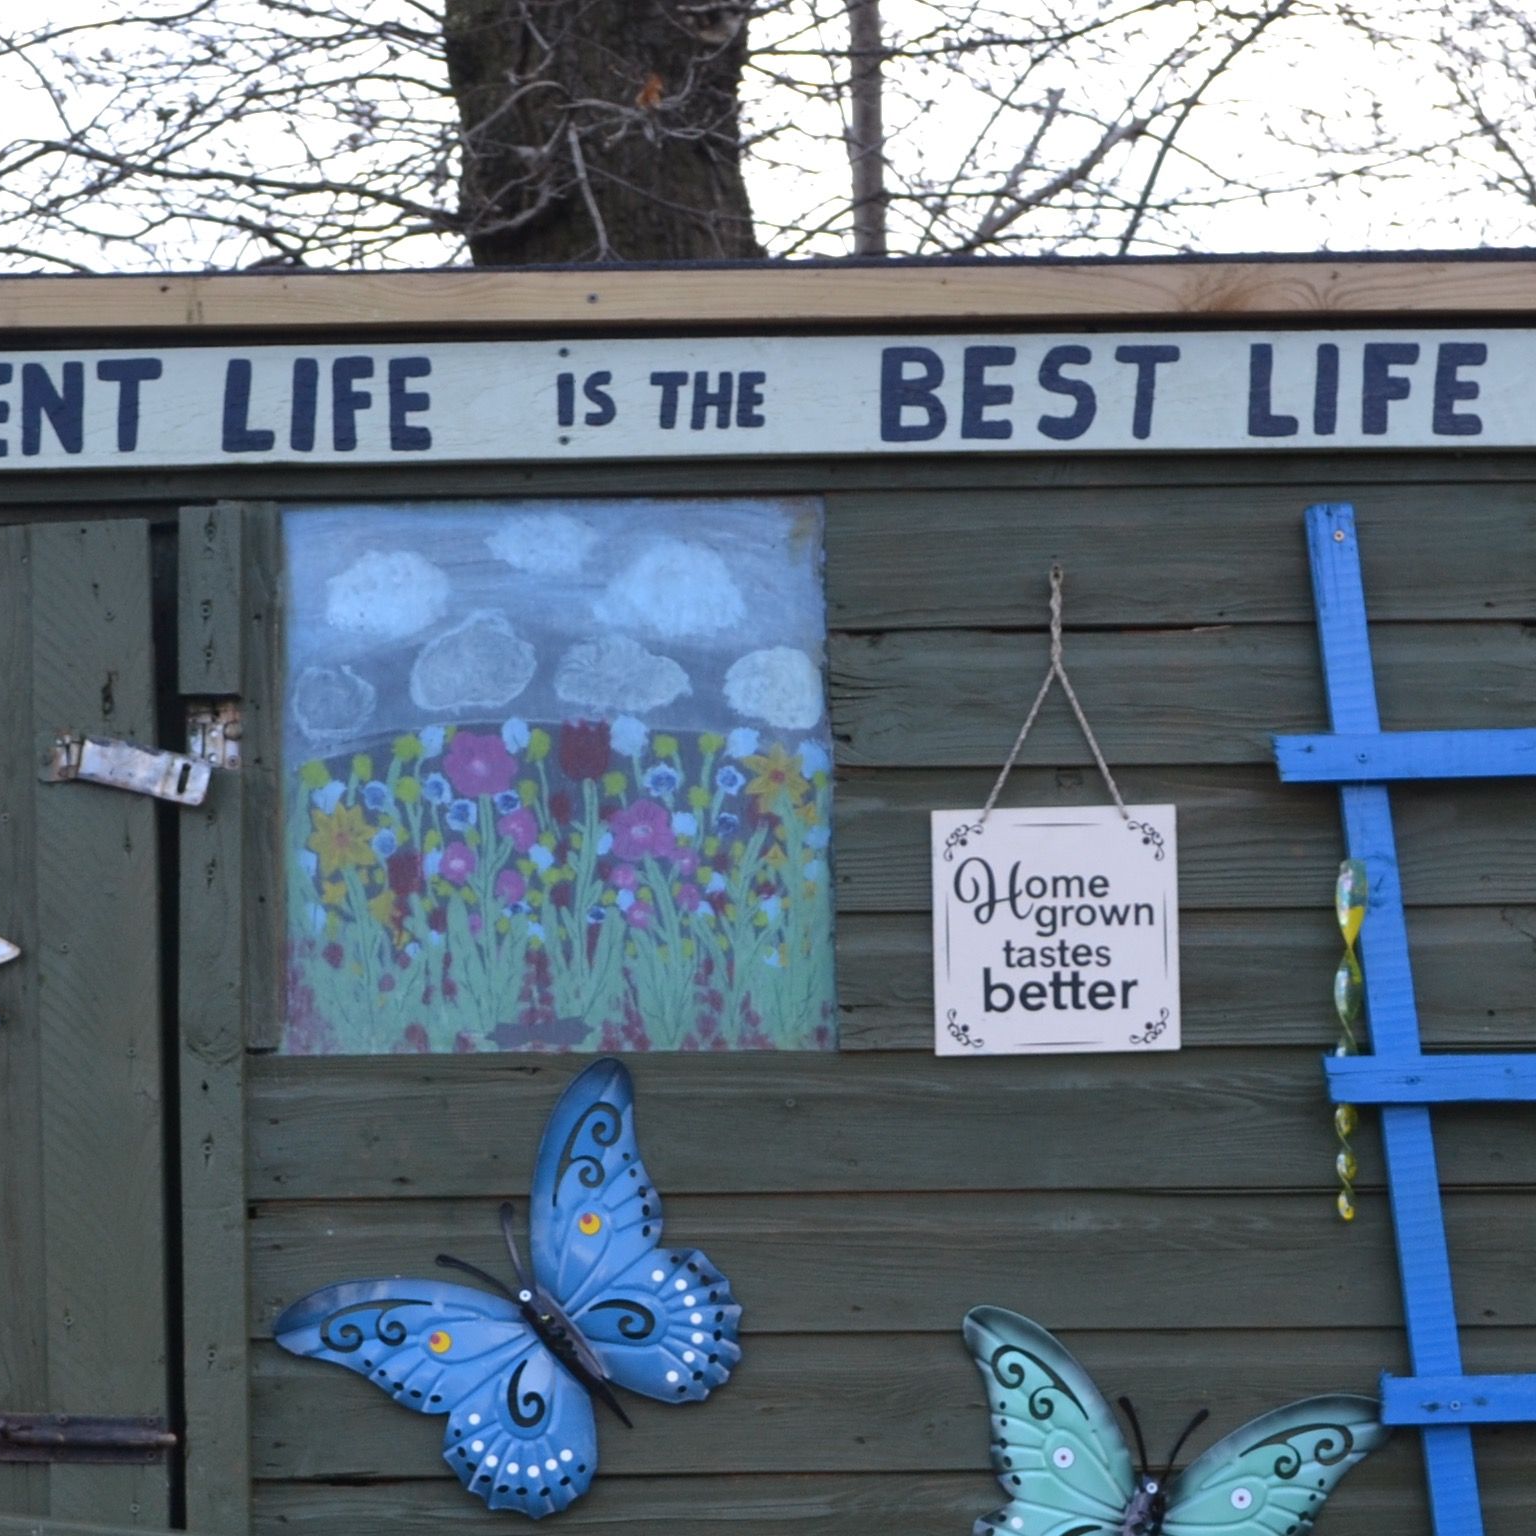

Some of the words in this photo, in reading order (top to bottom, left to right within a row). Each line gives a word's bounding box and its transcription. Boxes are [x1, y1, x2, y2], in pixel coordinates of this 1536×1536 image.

[221, 356, 434, 453] LIFE
[557, 371, 617, 428] IS
[650, 371, 765, 430] THE
[880, 345, 1182, 442] BEST
[1247, 343, 1485, 438] LIFE
[955, 857, 1110, 924] Home
[1035, 903, 1154, 937] grown
[1003, 939, 1112, 969] tastes
[983, 967, 1138, 1013] better
